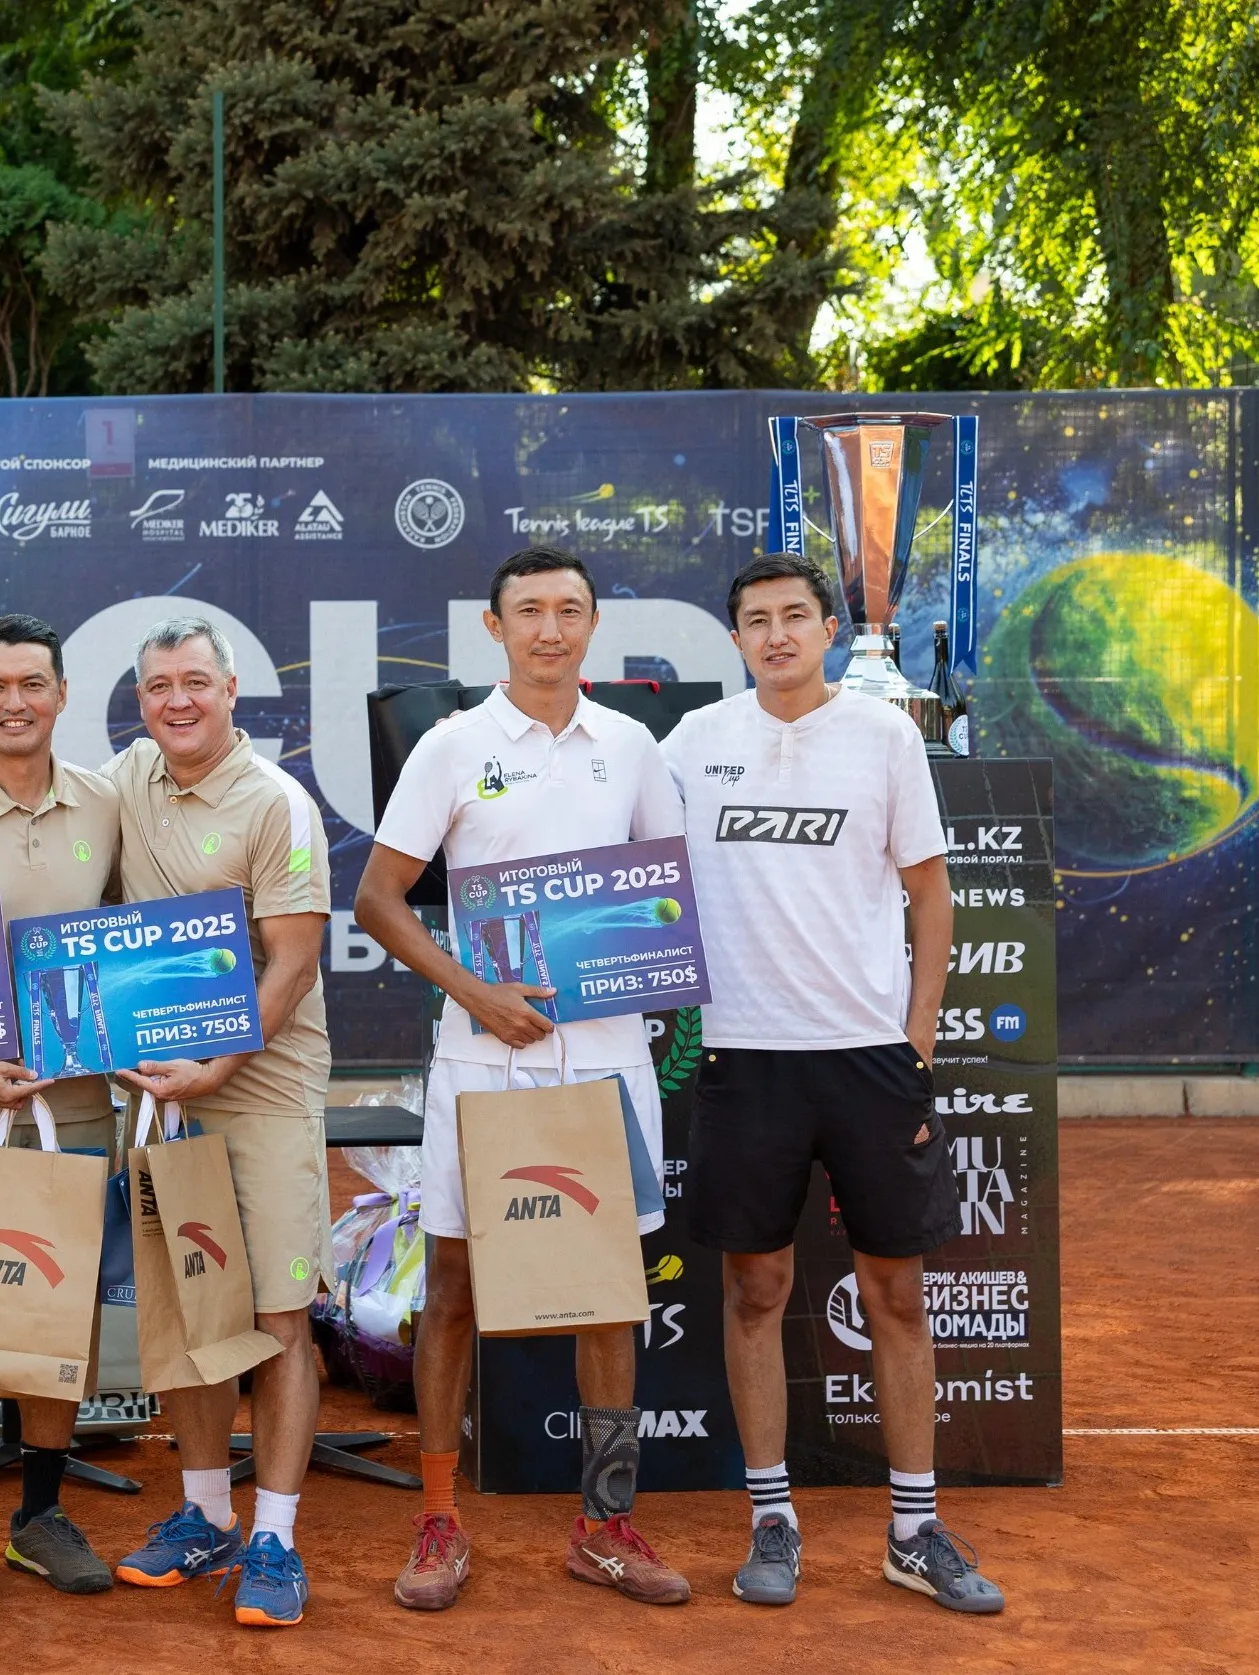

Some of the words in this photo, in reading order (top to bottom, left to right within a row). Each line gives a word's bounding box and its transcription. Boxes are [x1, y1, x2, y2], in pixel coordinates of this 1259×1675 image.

[24, 458, 92, 470] СПОНСОР
[148, 456, 257, 470] МЕДИЦИНСКИЙ
[260, 457, 324, 469] ПАРТНЕР
[50, 525, 92, 538] БАРНОЕ
[199, 520, 279, 537] MEDIKER
[294, 523, 331, 531] ALATAU
[504, 507, 571, 537] Tennis
[575, 508, 635, 542] league
[636, 504, 669, 534] TS
[294, 532, 343, 540] ASSISTANCE
[958, 522, 972, 583] FINALS
[705, 765, 745, 775] UNITED
[721, 770, 740, 787] Cup
[719, 810, 841, 841] PARI
[981, 855, 1023, 864] ПОРТАЛ
[499, 858, 583, 883] ИТОГОВЫЙ
[501, 883, 537, 907] TS
[544, 873, 604, 901] CUP
[610, 861, 681, 892] 2025
[469, 890, 488, 898] CUP
[951, 888, 1026, 907] NEWS
[60, 910, 142, 935] ИТОГОВЫЙ
[61, 934, 97, 958] TS
[103, 925, 162, 953] CUP
[168, 913, 237, 943] 2025
[29, 941, 48, 949] CUP
[576, 945, 693, 970] ЧЕТВЕРТЬФИНАЛИСТ
[580, 974, 644, 997] ПРИЗ:
[647, 965, 698, 988] 750$
[132, 994, 247, 1019] ЧЕТВЕРТЬФИНАЛИСТ
[136, 1023, 198, 1047] ПРИЗ:
[202, 1013, 251, 1036] 750$
[996, 1016, 1019, 1029] FM
[932, 1056, 960, 1065] звучит
[962, 1055, 988, 1065] успех!
[1020, 1136, 1029, 1235] MAGAZINE
[504, 1194, 562, 1222] ANTA
[184, 1250, 206, 1279] ANTA
[107, 1287, 137, 1300] CRU
[534, 1309, 595, 1321] www.anta.com
[826, 1413, 881, 1424] только
